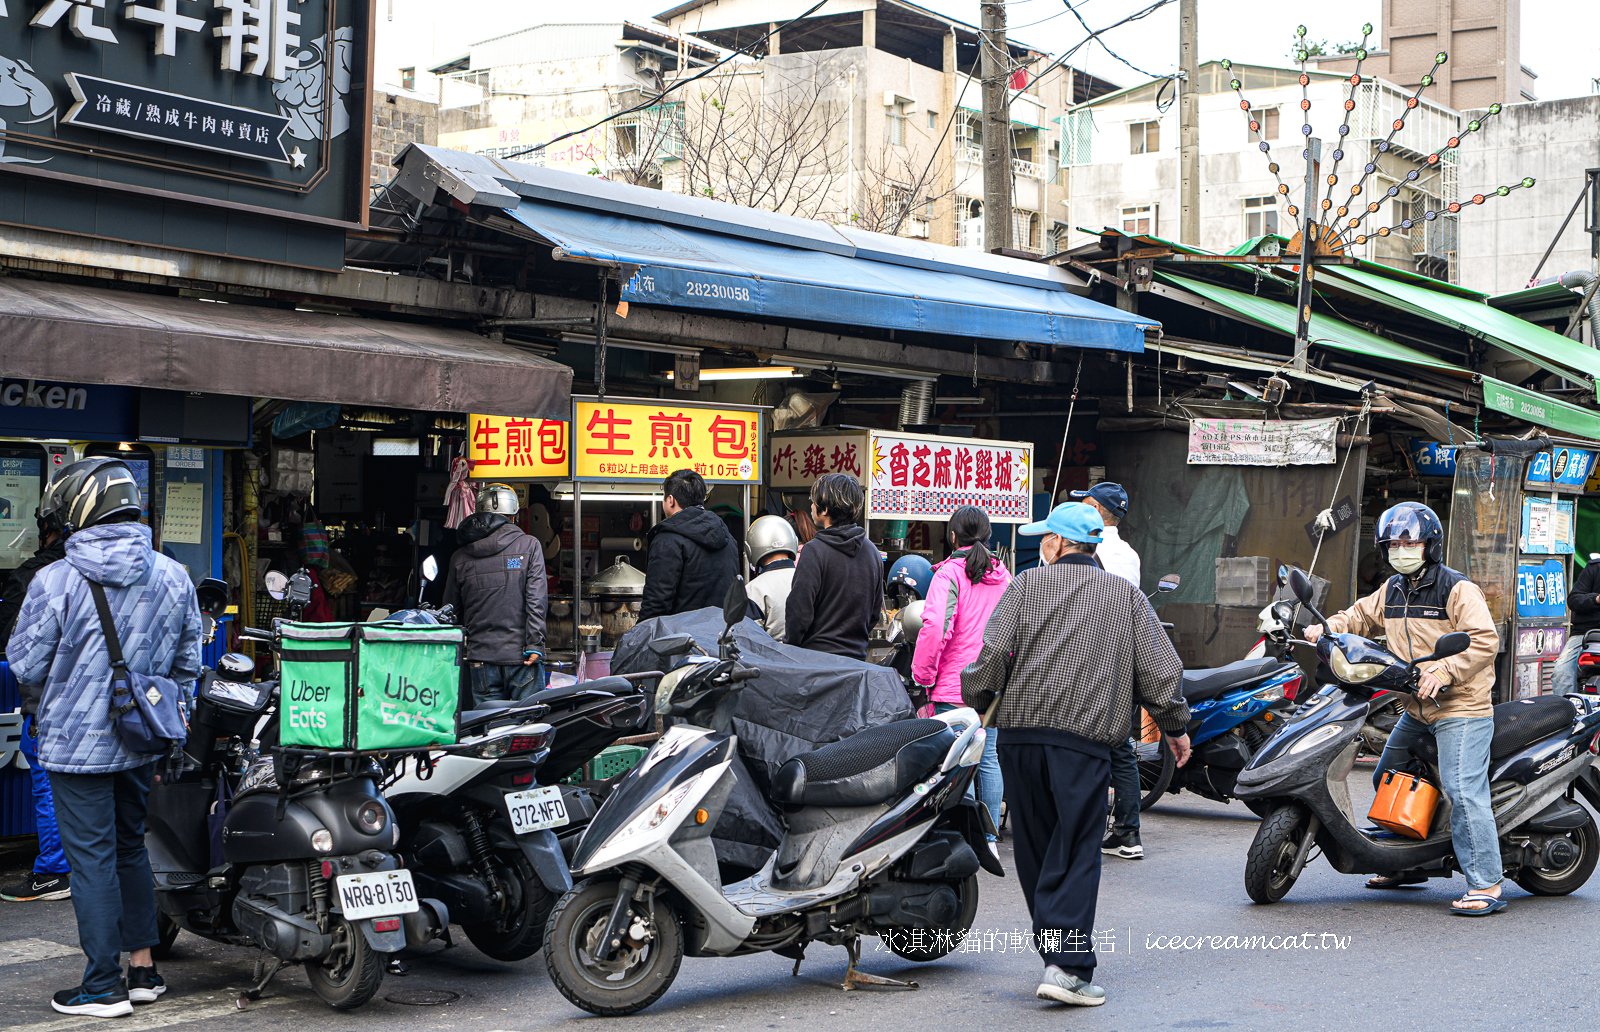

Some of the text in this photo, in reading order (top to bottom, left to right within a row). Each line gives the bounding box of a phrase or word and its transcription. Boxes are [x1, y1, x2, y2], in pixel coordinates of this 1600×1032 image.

[95, 93, 270, 145] 冷藏/熟成牛肉專賣店
[499, 129, 520, 144] 專營
[686, 281, 750, 302] 28230058
[1520, 401, 1546, 419] 28230058
[473, 417, 566, 467] 生煎包
[586, 409, 749, 460] 生煎包
[168, 447, 203, 460] 點餐區
[773, 442, 861, 480] 炸雞城
[1417, 447, 1452, 468] 石牌
[599, 463, 669, 476] 6粒以上用盒裝
[889, 442, 1013, 492] 香芝麻炸雞城
[290, 679, 331, 702] Uber
[383, 672, 440, 708] Uber
[289, 706, 327, 729] Eats
[380, 702, 437, 732] Eats
